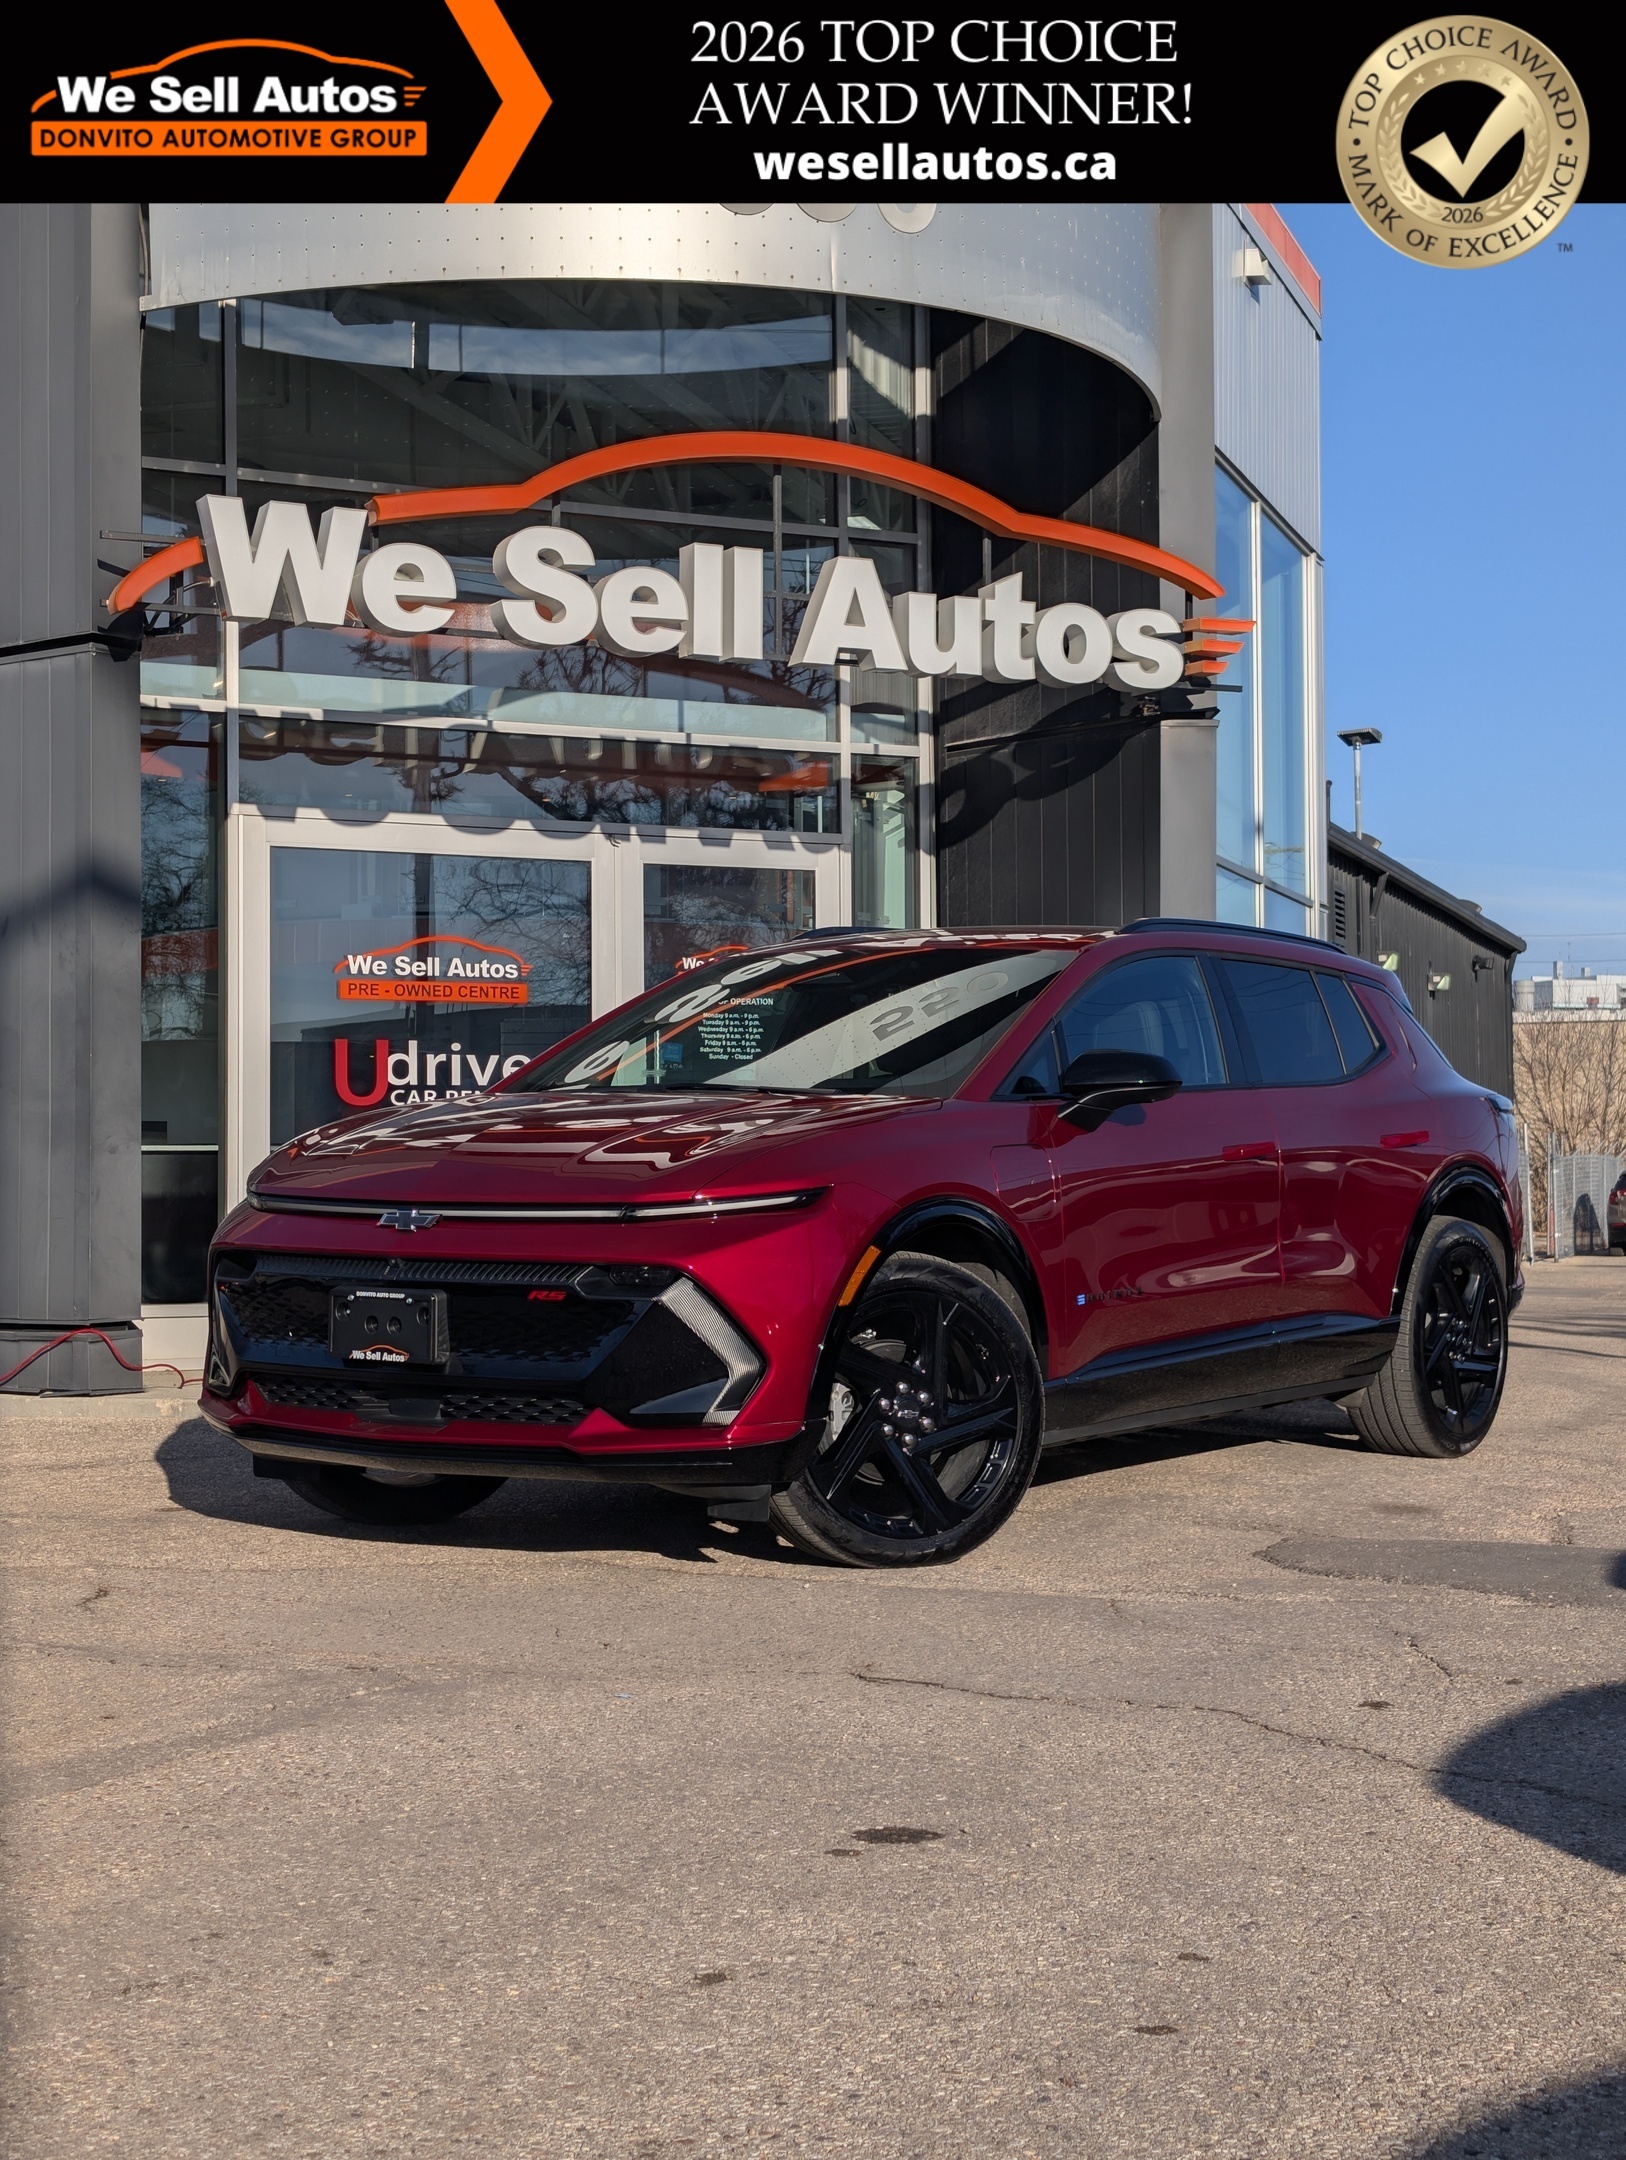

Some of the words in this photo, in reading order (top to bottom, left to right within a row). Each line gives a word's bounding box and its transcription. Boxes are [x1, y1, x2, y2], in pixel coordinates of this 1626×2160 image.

[196, 493, 458, 638] We
[491, 525, 764, 662] Sell
[788, 556, 1185, 692] Autos
[347, 954, 388, 976] We
[394, 955, 440, 978] Sell
[446, 957, 519, 979] Autos
[347, 983, 380, 997] PRE
[396, 983, 453, 998] OWNED
[457, 985, 520, 999] CENTRE
[730, 998, 774, 1006] OPERATION
[390, 1090, 437, 1106] CAR
[528, 1290, 566, 1301] RS
[352, 1350, 365, 1360] We
[365, 1351, 381, 1361] Sell
[382, 1352, 405, 1363] Autos
